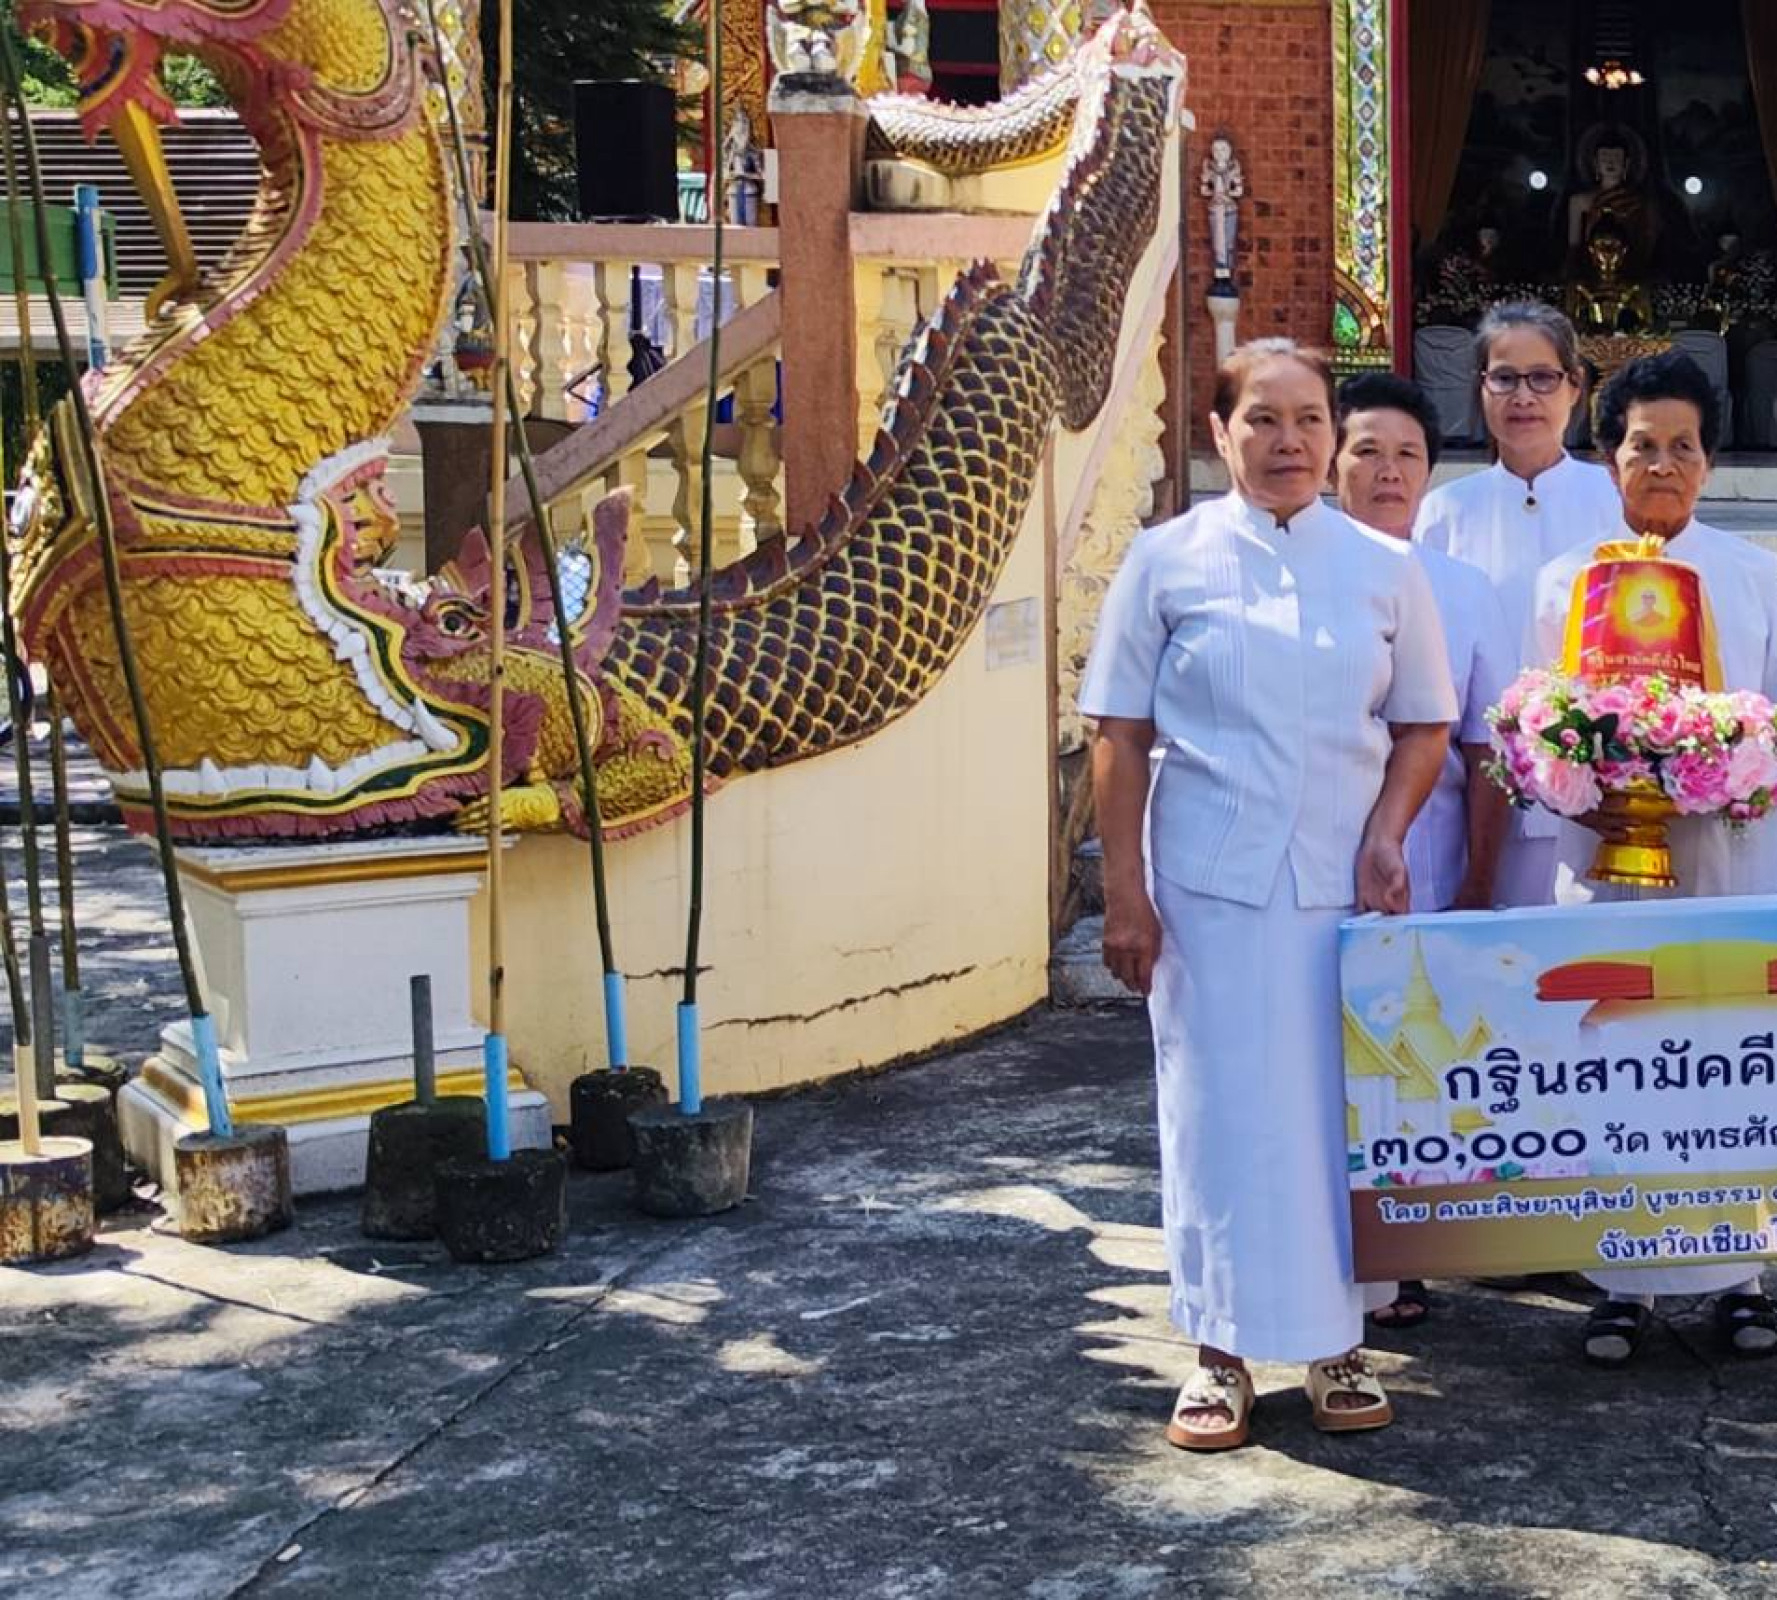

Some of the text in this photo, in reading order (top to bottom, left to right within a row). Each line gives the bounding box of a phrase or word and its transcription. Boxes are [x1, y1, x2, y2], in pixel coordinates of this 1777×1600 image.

[1371, 1128, 1587, 1169] ๓๐,๐๐๐
[1603, 1120, 1649, 1154] วัด
[1380, 1199, 1428, 1221] โดย
[1439, 1186, 1635, 1219] คณะศิษยานุศิษย์
[1645, 1186, 1761, 1214] บูชาธรรม
